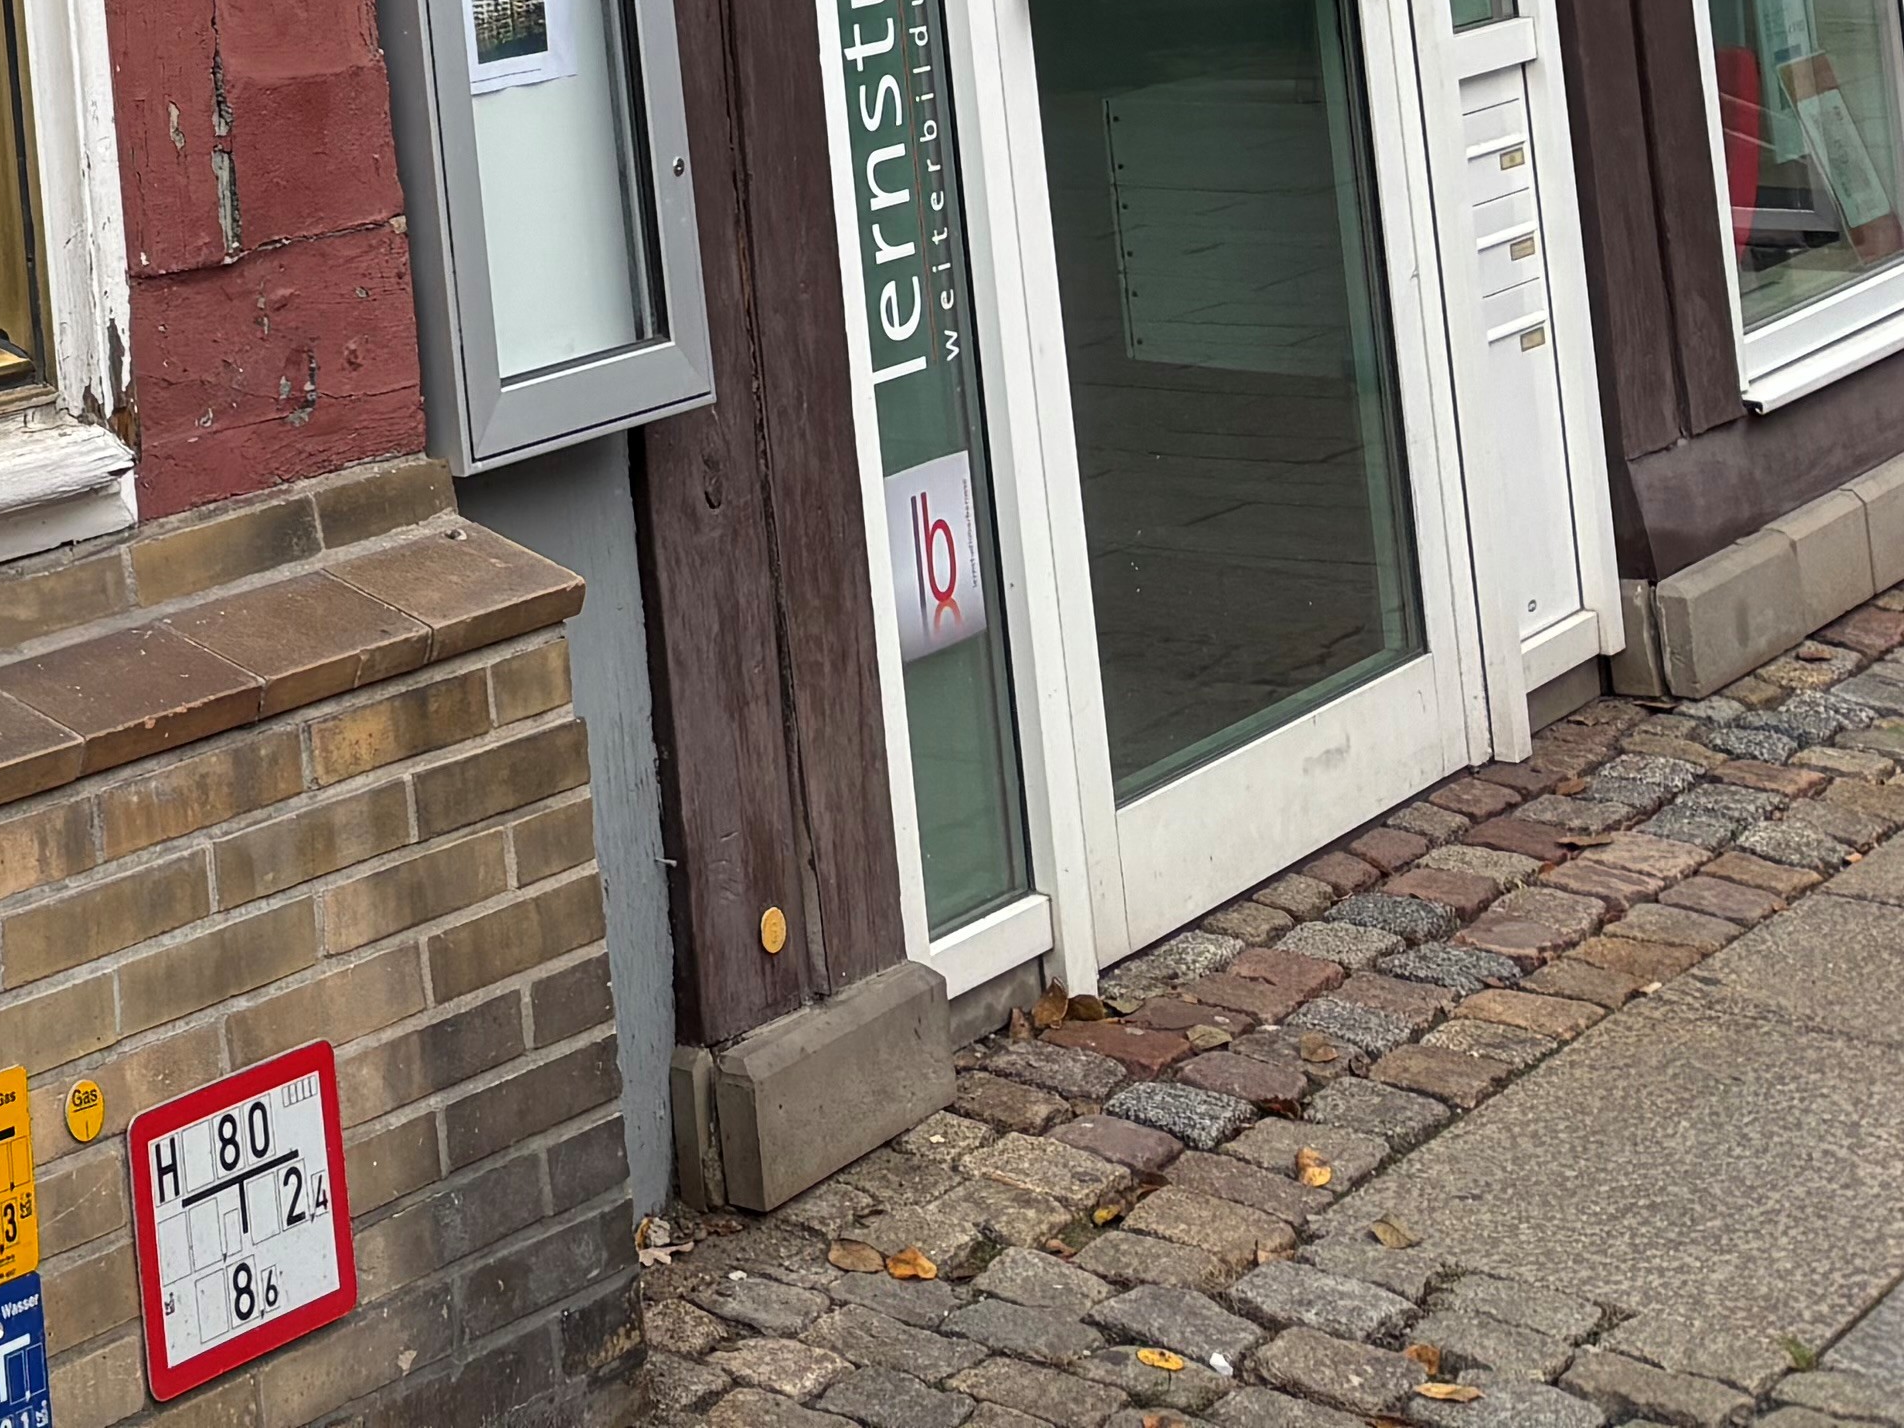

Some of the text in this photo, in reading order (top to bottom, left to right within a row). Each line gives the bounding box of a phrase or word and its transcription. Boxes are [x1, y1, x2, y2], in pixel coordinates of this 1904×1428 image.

[71, 1087, 99, 1108] Gas
[154, 1100, 271, 1204] H 80
[0, 1293, 40, 1320] Wasser
